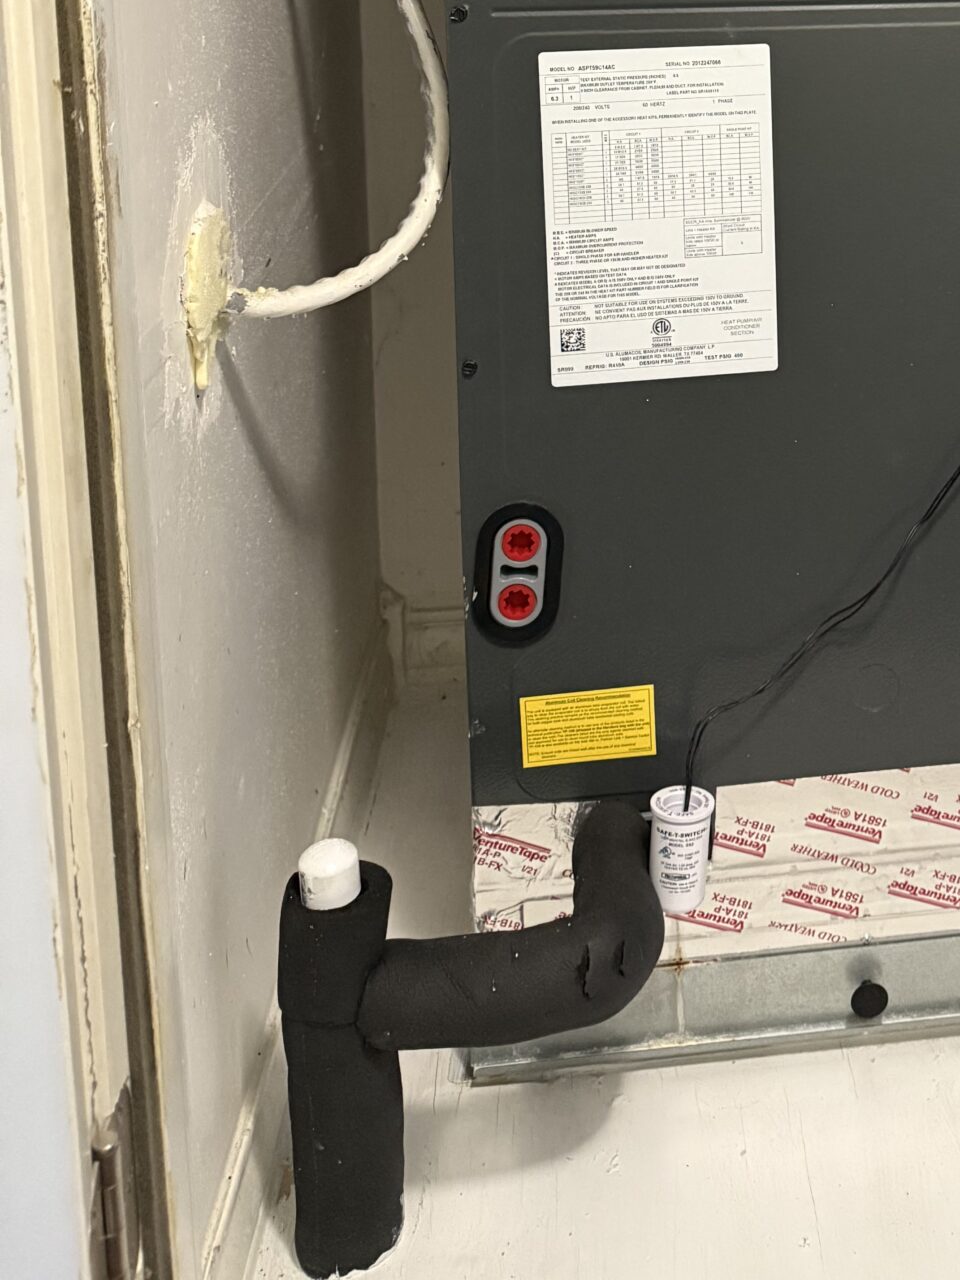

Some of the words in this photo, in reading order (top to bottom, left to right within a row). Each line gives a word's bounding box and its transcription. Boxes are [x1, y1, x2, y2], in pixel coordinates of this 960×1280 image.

[870, 785, 901, 800] COLD
[734, 816, 776, 834] 181B-FX
[807, 812, 883, 839] VentureTape
[854, 811, 887, 828] 1581A
[736, 828, 771, 842] 181A-P
[790, 843, 839, 863] WEATHER
[711, 892, 753, 910] 181B-FX
[784, 888, 860, 915] VentureTape
[831, 886, 864, 904] 1581A
[714, 905, 748, 920] 181A-P
